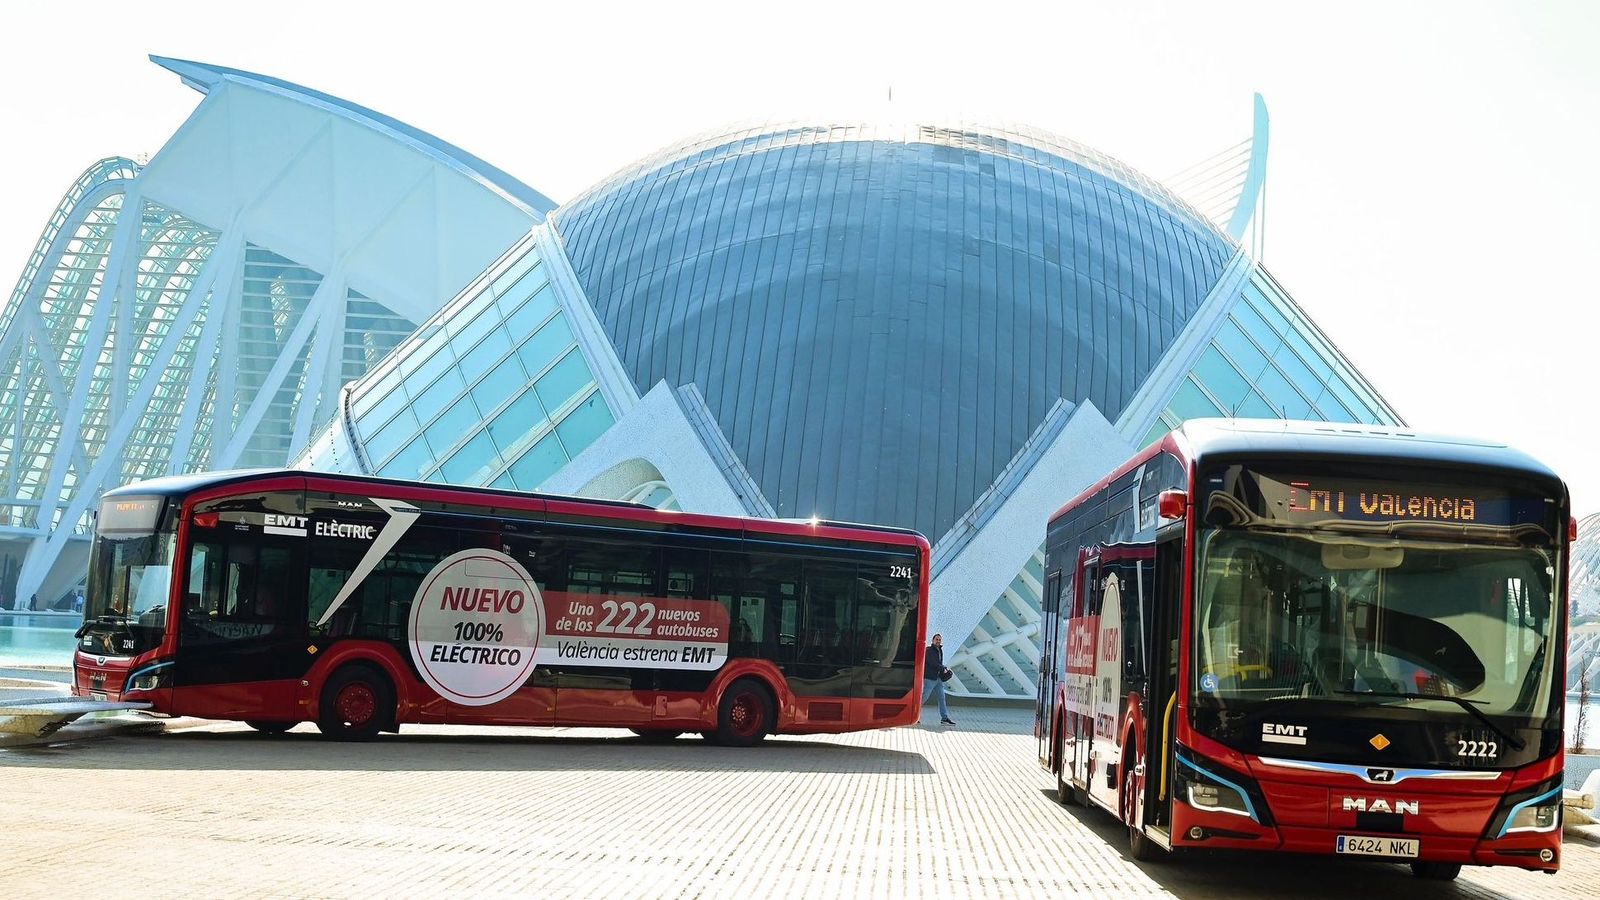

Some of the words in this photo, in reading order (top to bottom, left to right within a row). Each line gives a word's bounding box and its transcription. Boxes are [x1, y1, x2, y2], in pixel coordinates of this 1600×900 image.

[264, 514, 308, 527] EMT
[315, 519, 374, 540] ELÈCTRIC
[890, 566, 912, 579] 2241
[440, 586, 525, 614] NUEVO
[568, 601, 595, 616] Uno
[595, 600, 656, 635] 222
[657, 608, 701, 622] nuevos
[454, 621, 504, 642] 100%
[555, 616, 572, 631] de
[574, 617, 594, 632] los
[657, 623, 719, 638] autobuses
[430, 642, 522, 666] ELÉCTRICO
[557, 640, 619, 660] València
[623, 648, 677, 663] estrena
[681, 646, 716, 664] EMT
[1262, 723, 1308, 737] EMT
[1458, 740, 1498, 758] 2222
[1342, 796, 1419, 815] MAN
[1348, 838, 1383, 853] 6424
[1390, 841, 1415, 855] NKL
